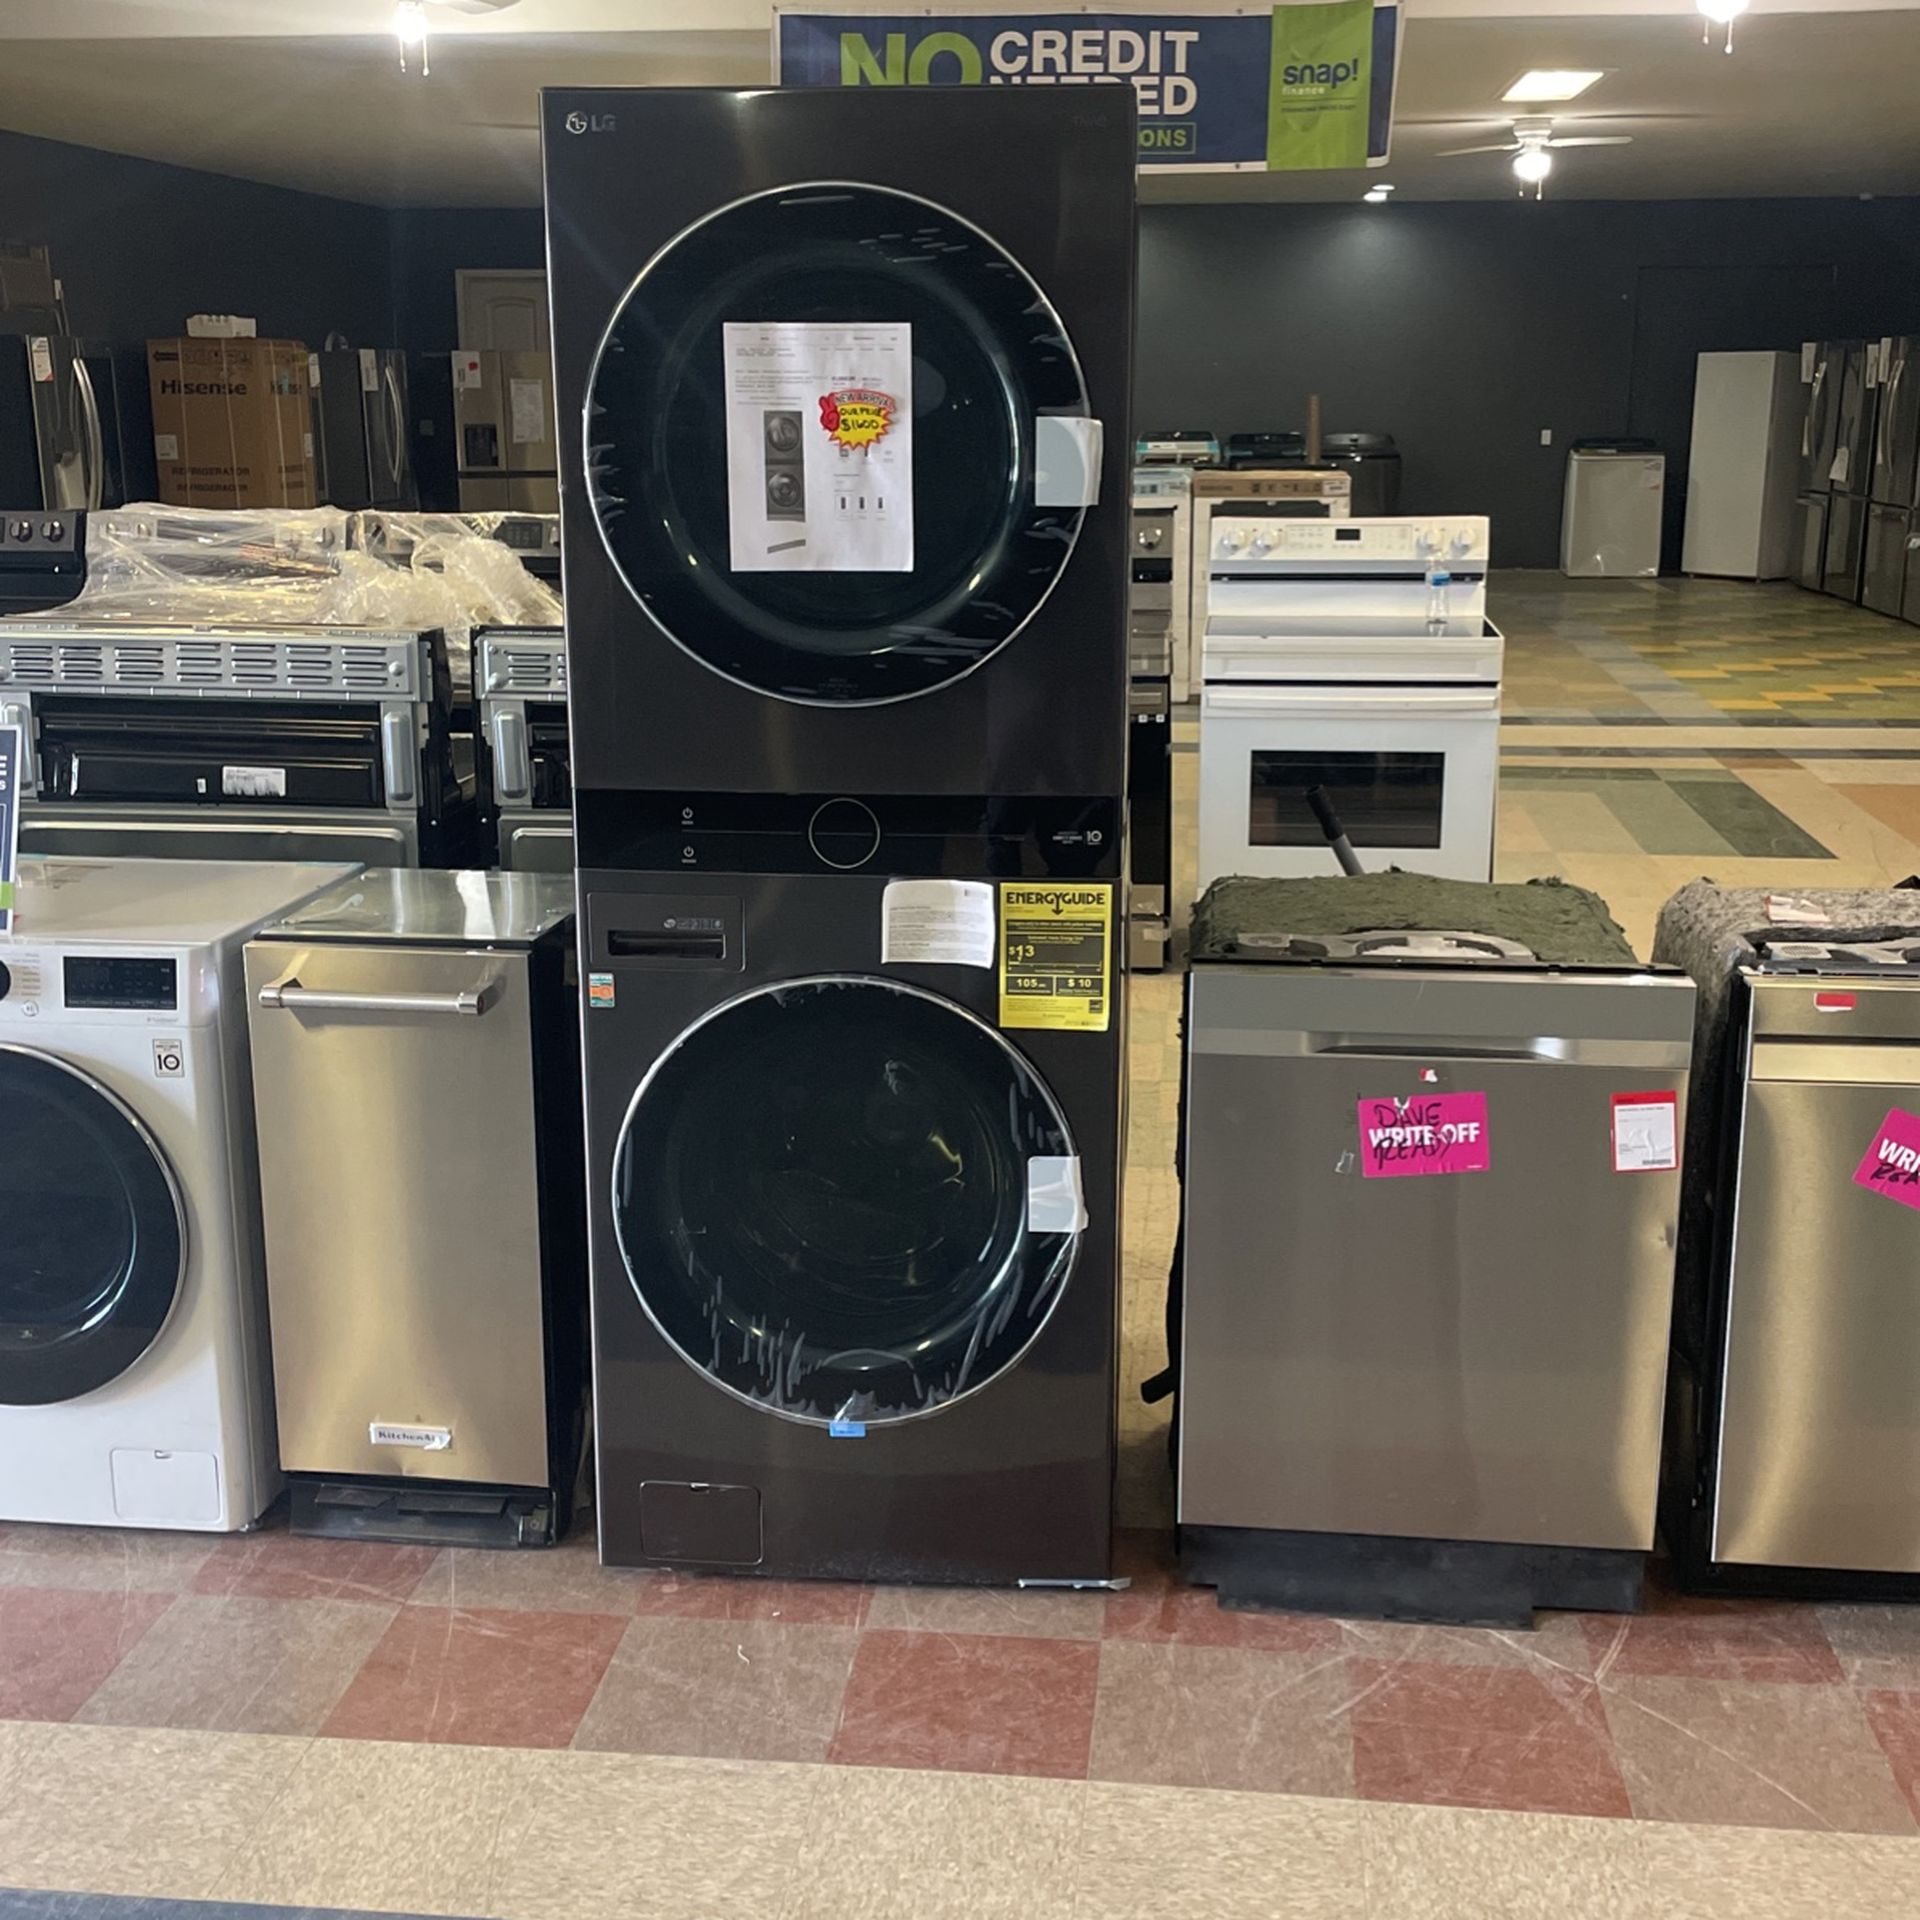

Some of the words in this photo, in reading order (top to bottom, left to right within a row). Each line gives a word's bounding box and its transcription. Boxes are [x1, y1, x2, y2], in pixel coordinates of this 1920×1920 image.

[840, 31, 983, 85] NO
[990, 30, 1199, 74] CREDIT
[1283, 58, 1359, 90] snap!
[591, 114, 616, 132] LG
[160, 379, 248, 396] Hisense
[1006, 892, 1105, 909] ENERGYGUIDE
[1008, 945, 1035, 958] $13
[1017, 978, 1038, 988] 105
[1079, 978, 1092, 988] 10
[1373, 1102, 1442, 1128] DAVE
